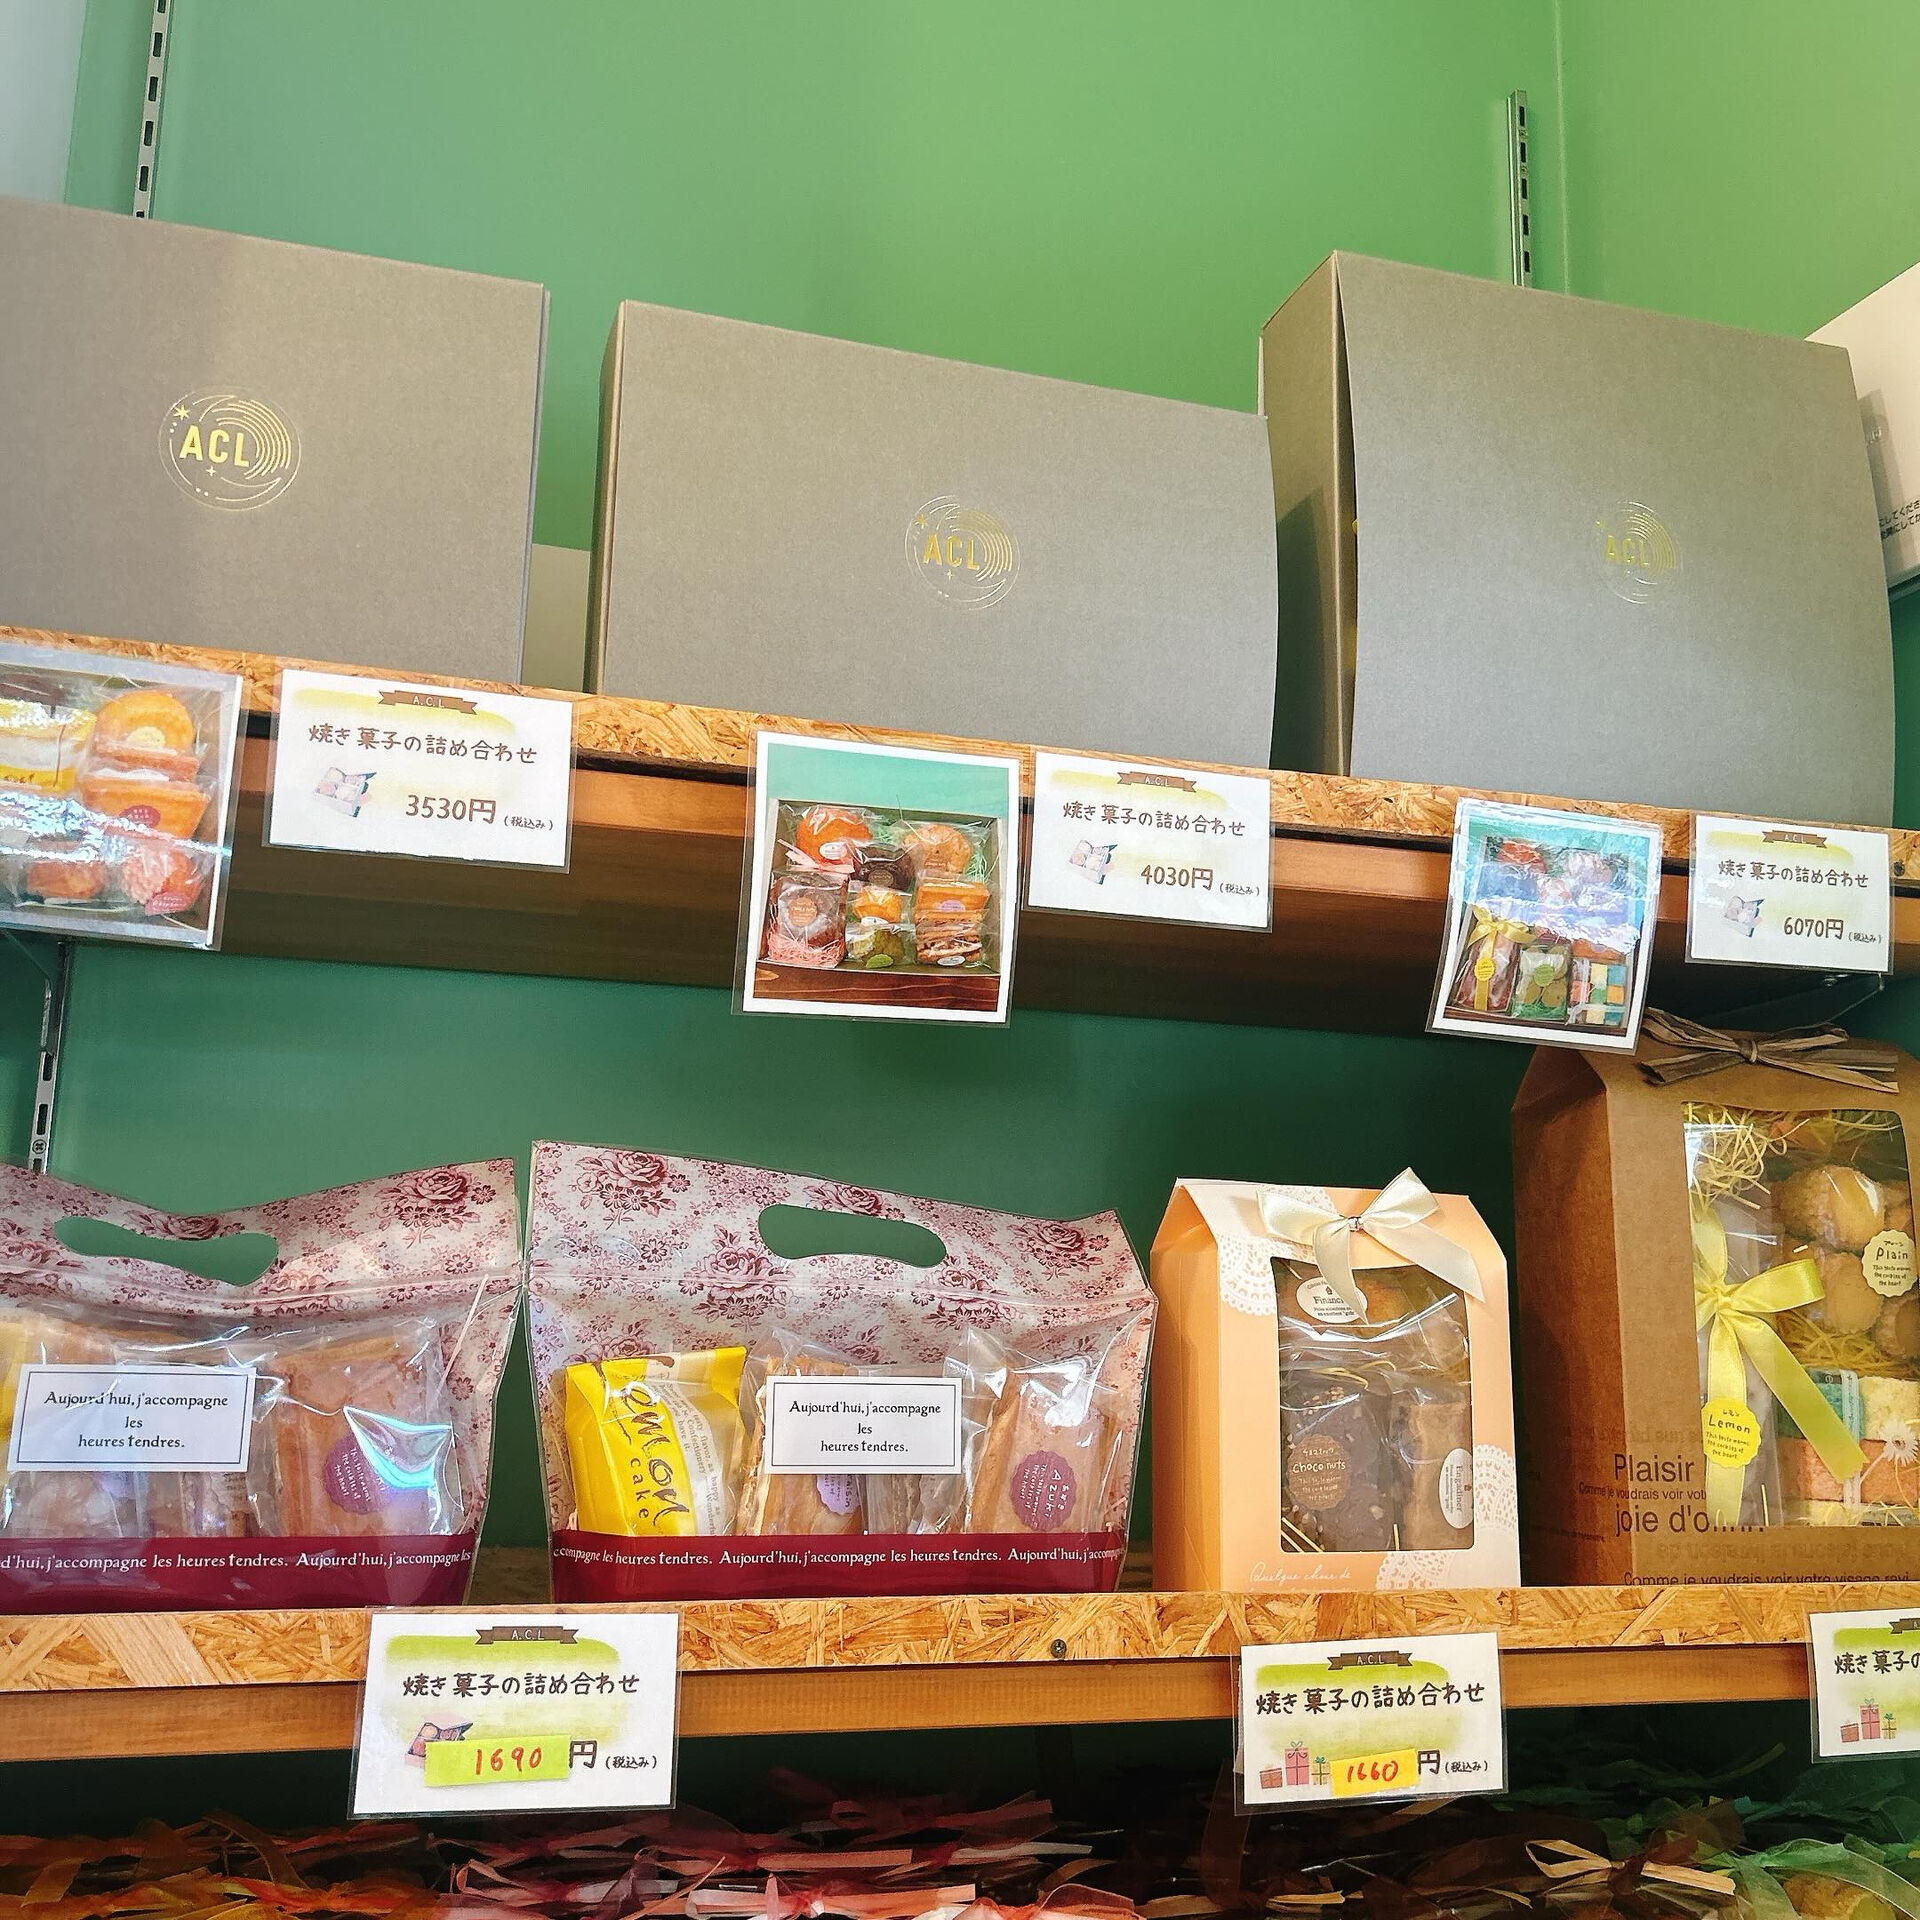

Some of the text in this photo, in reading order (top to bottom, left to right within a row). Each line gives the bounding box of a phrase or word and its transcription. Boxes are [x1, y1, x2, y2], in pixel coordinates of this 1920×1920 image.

[179, 425, 250, 468] ACL
[922, 532, 980, 571] ACL
[1605, 534, 1651, 570] ACL
[413, 695, 445, 708] A.C.L
[308, 722, 538, 765] 焼き菓子の詰め合わせ
[405, 794, 554, 831] 3530円 (税込み)
[1063, 800, 1246, 837] 焼き菓子の詰め合わせ
[1140, 864, 1214, 891] 4030円
[1783, 916, 1845, 940] 6070円
[1876, 1246, 1908, 1260] Plain
[124, 1415, 144, 1429] les
[857, 1423, 873, 1435] les
[1709, 1414, 1750, 1434] Lemon
[78, 1434, 185, 1448] heures tendres.
[820, 1440, 909, 1453] heures tendres.
[1326, 1460, 1346, 1470] nuts
[1613, 1453, 1695, 1483] Plaisir
[629, 1457, 651, 1519] cake
[1616, 1486, 1659, 1500] voudrais
[1661, 1488, 1684, 1500] voir
[1615, 1503, 1659, 1537] joie
[152, 1554, 173, 1567] les
[177, 1553, 226, 1567] heures
[228, 1553, 289, 1567] tendres.
[602, 1550, 614, 1564] les
[615, 1551, 656, 1565] heures
[659, 1551, 713, 1565] tendres.
[890, 1549, 907, 1563] les
[910, 1550, 950, 1562] heures
[952, 1549, 1002, 1562] tendres.
[1624, 1571, 1680, 1585] Comme
[1700, 1571, 1761, 1584] voudrais
[1766, 1573, 1793, 1583] voir
[510, 1628, 545, 1641] A.C.L
[1356, 1653, 1385, 1666] A.C.L
[402, 1671, 640, 1698] 焼き菓子の詰め合わせ
[1256, 1681, 1485, 1716] 焼き菓子の詰め合わせ
[474, 1739, 657, 1776] 1690 円 (税込み)
[1347, 1749, 1488, 1783] 1660 円 (税込み)
